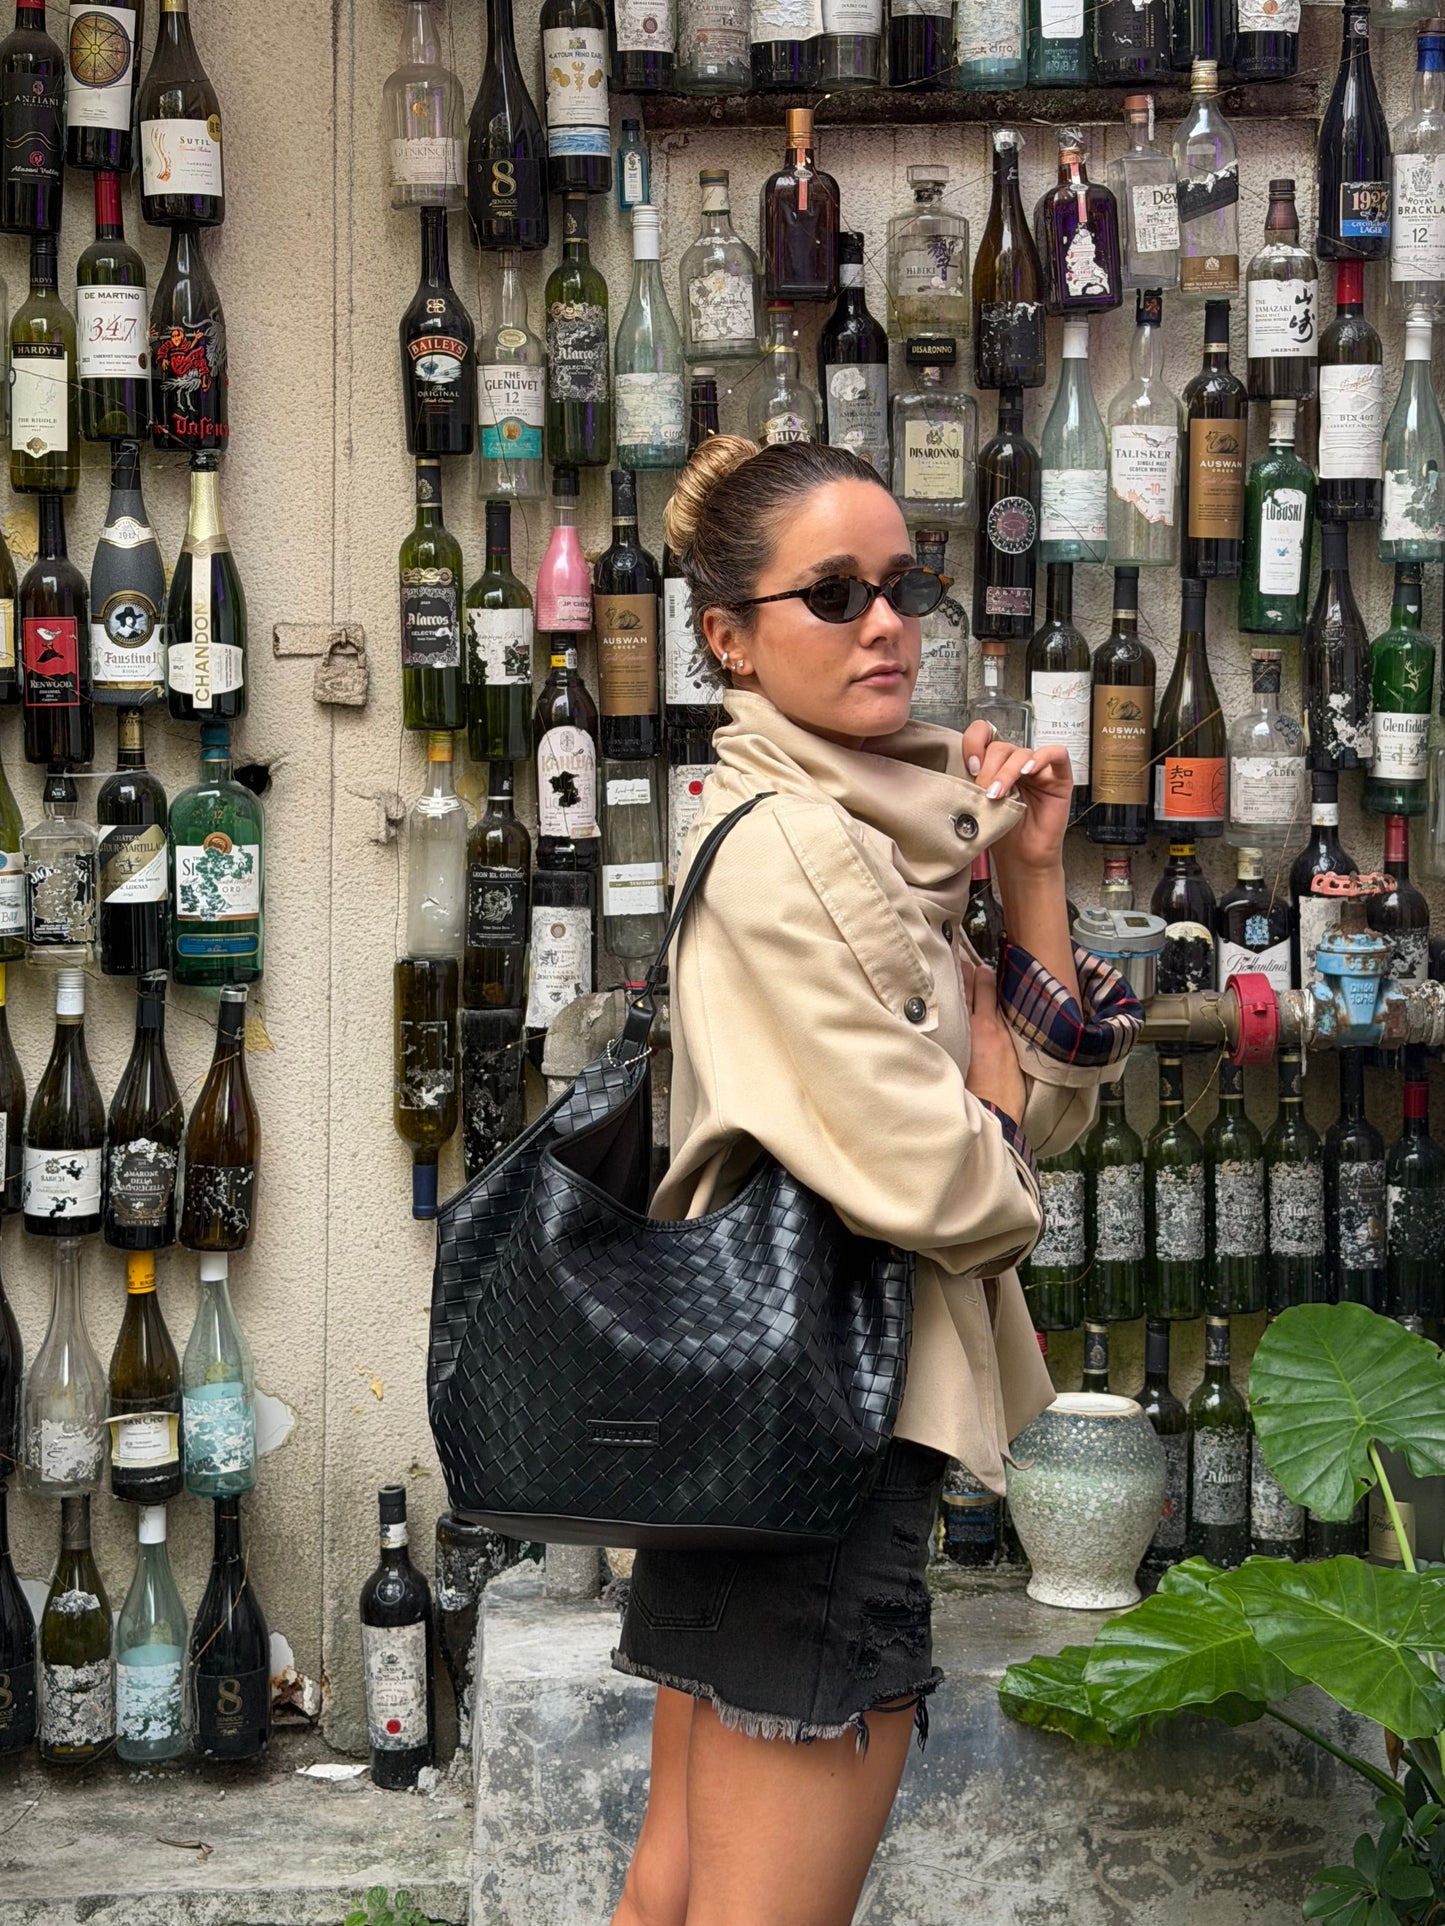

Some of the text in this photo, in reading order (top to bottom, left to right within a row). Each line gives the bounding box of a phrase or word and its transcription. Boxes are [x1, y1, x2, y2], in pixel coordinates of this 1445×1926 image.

[180, 136, 210, 146] SUTIL
[492, 160, 516, 197] 8
[1408, 197, 1435, 207] ROYAL
[1398, 205, 1445, 215] BRACKLA
[1412, 228, 1428, 243] 12
[906, 267, 936, 275] HIBIKI
[31, 276, 53, 284] ARDYS
[85, 292, 140, 301] DE MARTINO
[1255, 305, 1292, 313] YAMAZAKI
[89, 313, 137, 342] 347
[17, 346, 58, 355] HARDYS
[411, 338, 465, 354] BAILEYS
[912, 345, 952, 354] DISARONNO
[503, 371, 521, 379] THE
[485, 380, 539, 392] GLENLIVET
[505, 392, 520, 404] 12
[767, 431, 811, 444] CHIVAS
[909, 447, 960, 459] DISARONNO
[1115, 449, 1171, 459] TALISKER
[1200, 460, 1242, 468] AUSWAN
[603, 637, 648, 645] AUSWAN
[194, 602, 210, 702] CHANDON
[104, 652, 150, 666] Faustino
[30, 679, 73, 689] RENWOOD
[1101, 726, 1146, 735] AUSWAN
[1383, 717, 1427, 734] Glenfidd
[217, 1678, 243, 1715] 8
